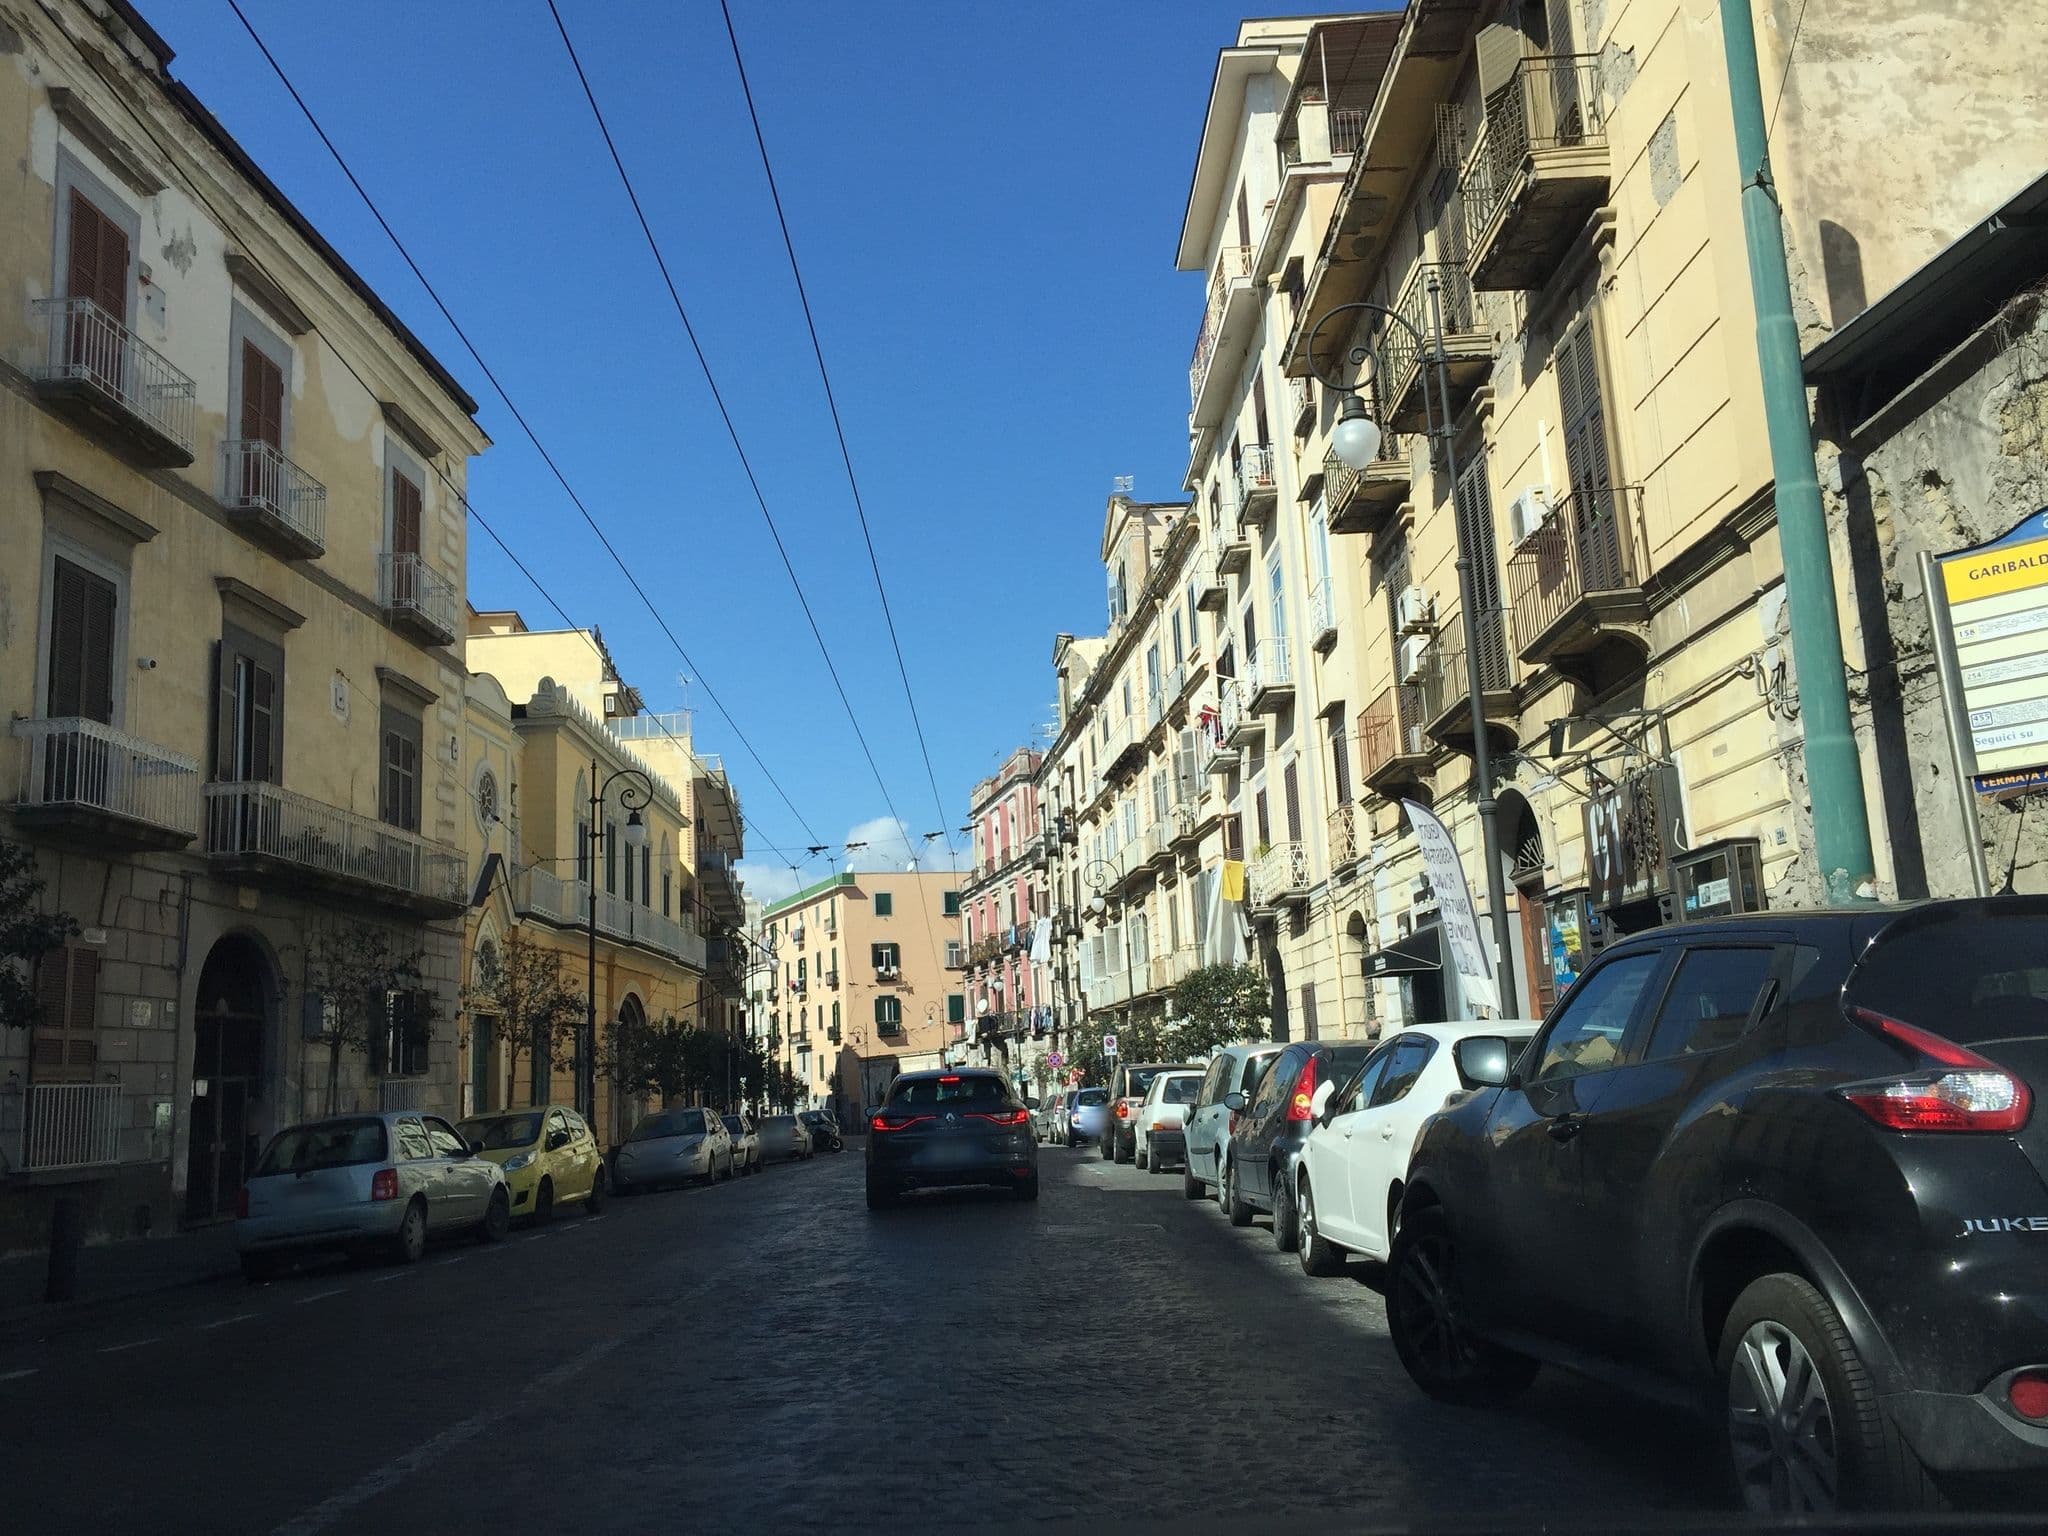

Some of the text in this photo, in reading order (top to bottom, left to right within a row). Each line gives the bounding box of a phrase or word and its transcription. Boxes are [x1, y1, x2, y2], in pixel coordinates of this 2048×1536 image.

[1975, 731, 2034, 746] Seguici su
[1955, 1216, 2048, 1239] JUKE
